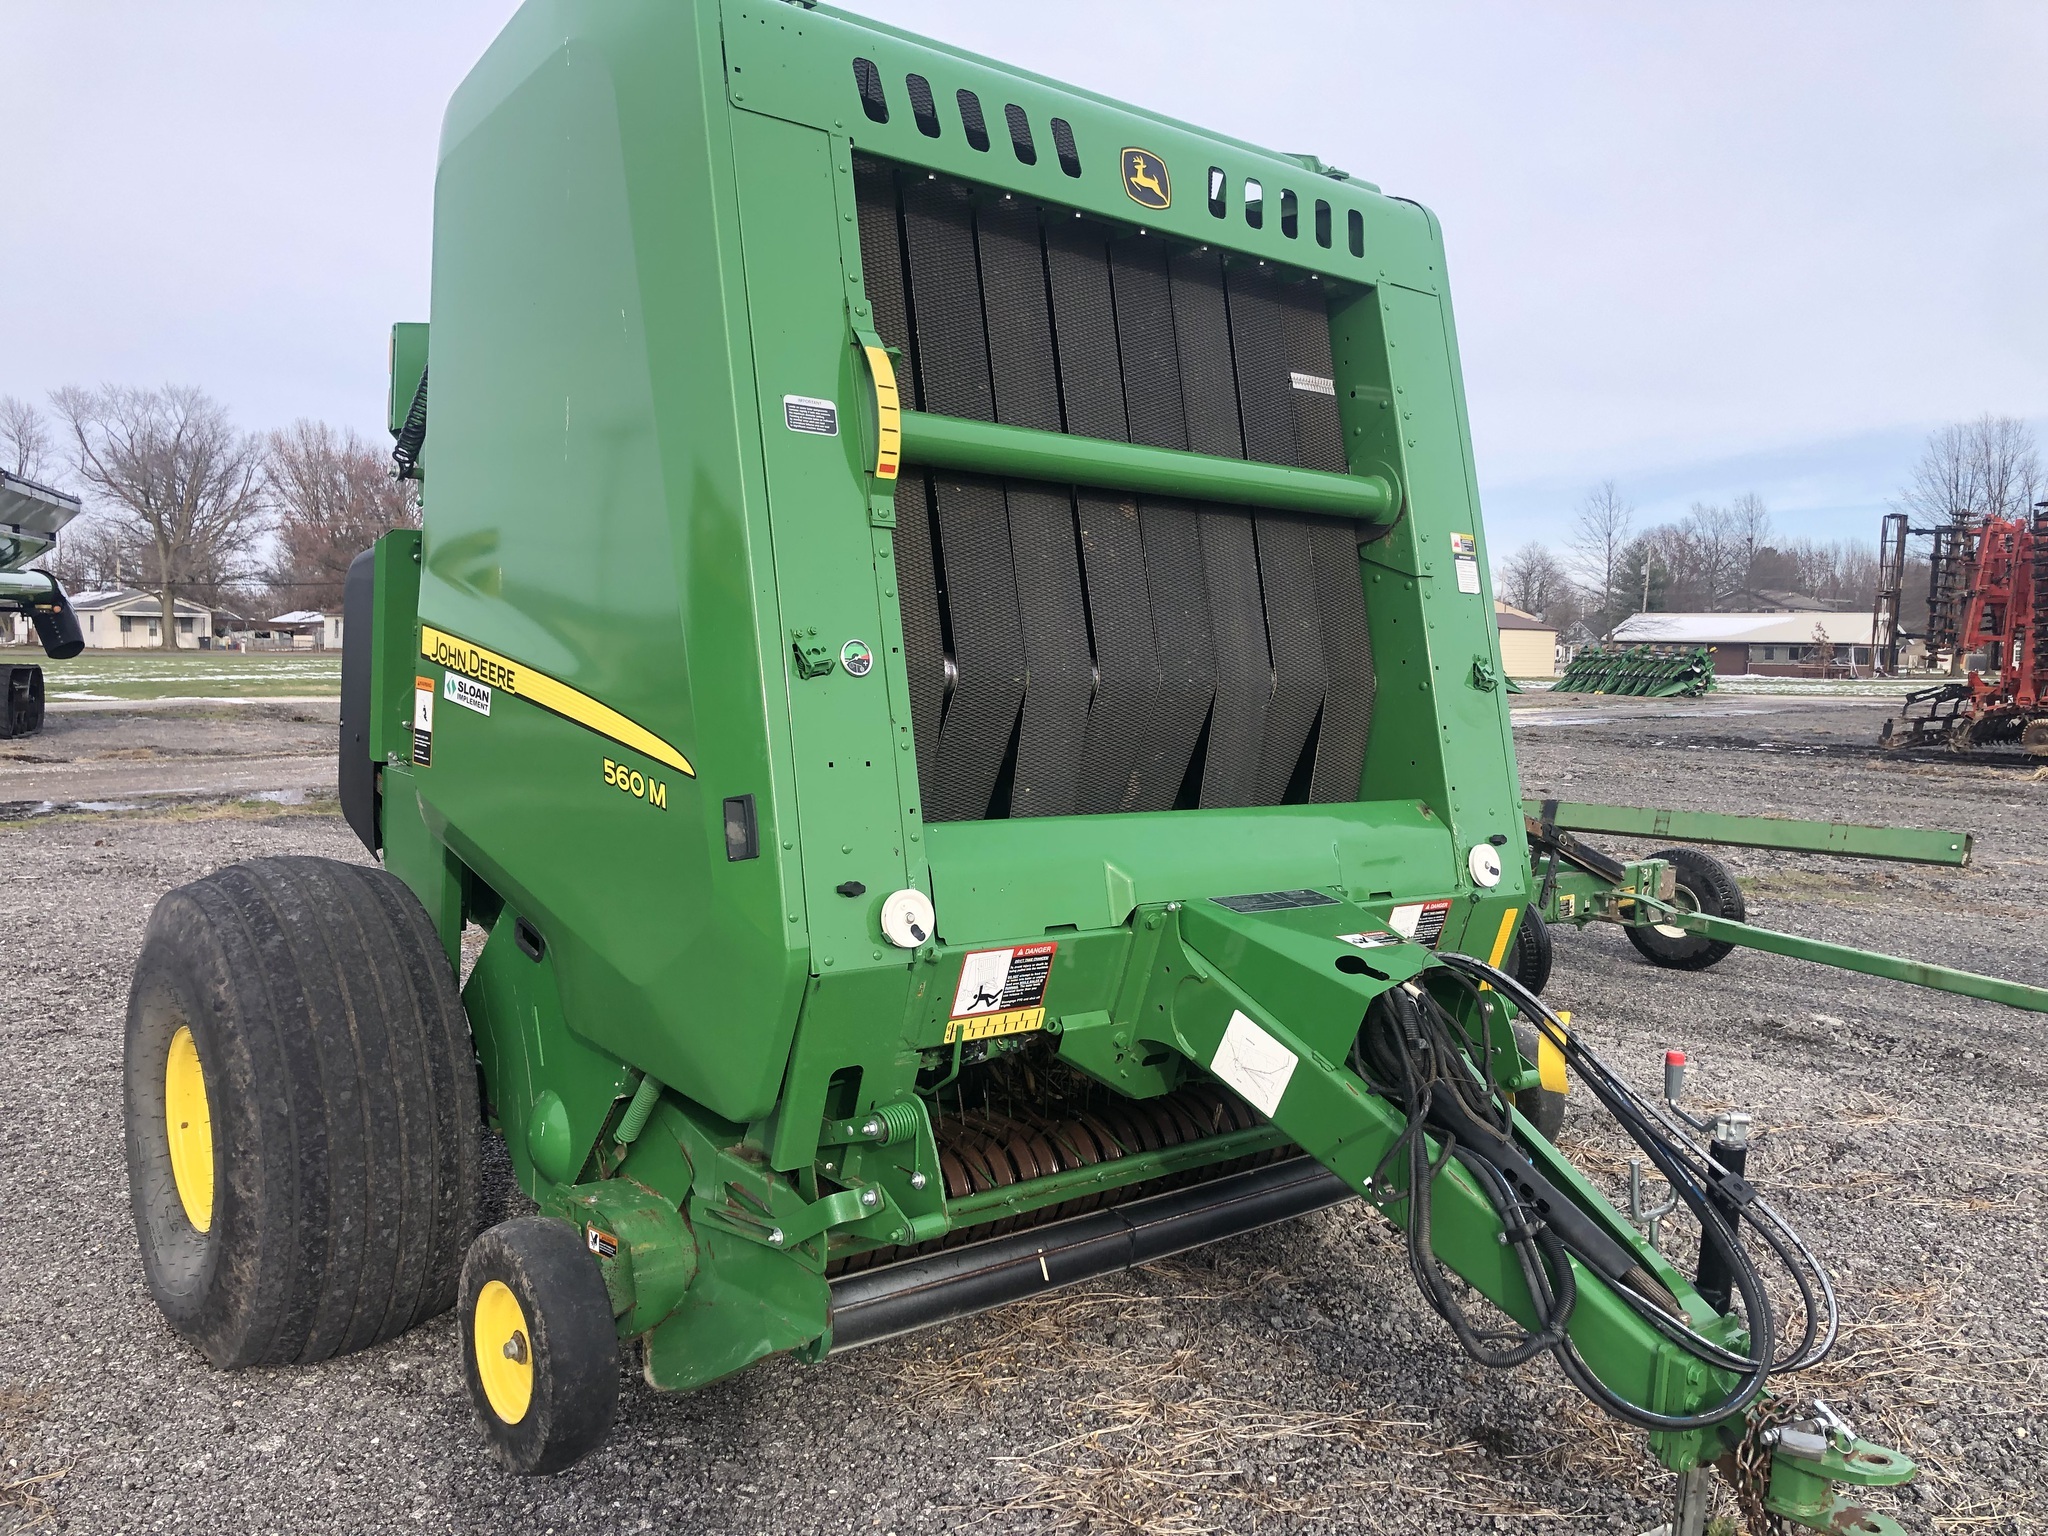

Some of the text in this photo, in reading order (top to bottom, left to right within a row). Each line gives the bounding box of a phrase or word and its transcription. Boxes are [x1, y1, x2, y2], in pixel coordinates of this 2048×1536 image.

[430, 636, 516, 691] JOHN DEERE
[456, 694, 489, 712] IMPLEMENT
[457, 681, 490, 703] SLOAN
[602, 756, 668, 811] 560 M
[1025, 946, 1051, 955] DANGER
